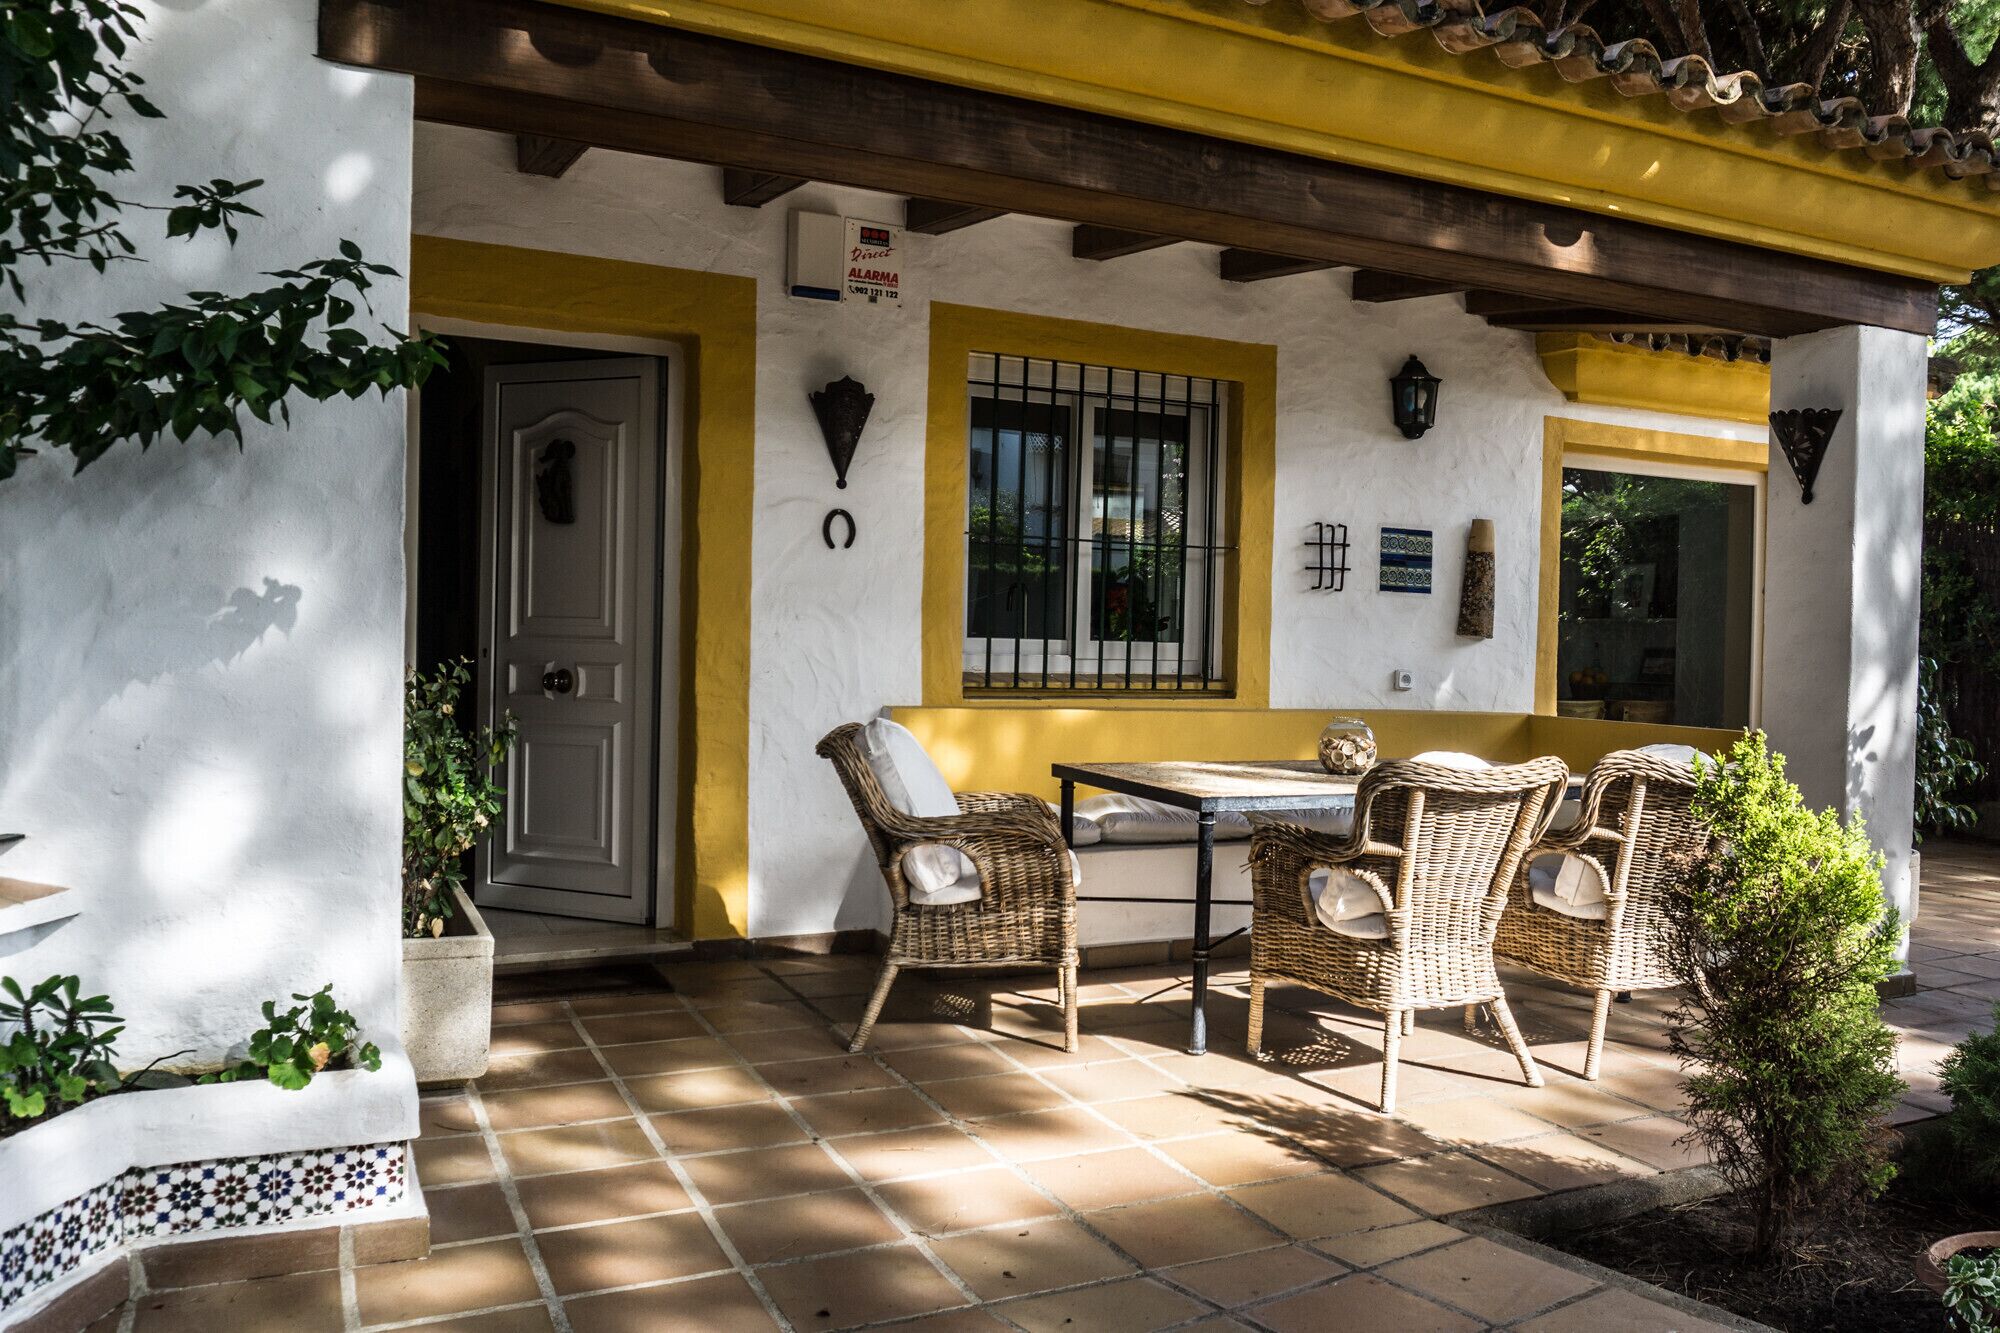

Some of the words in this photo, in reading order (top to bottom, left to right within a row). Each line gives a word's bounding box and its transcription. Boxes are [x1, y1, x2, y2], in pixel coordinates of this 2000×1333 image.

[851, 247, 896, 262] Direct
[848, 267, 898, 282] ALARMA
[854, 286, 868, 294] 902
[870, 288, 882, 296] 121
[885, 290, 898, 298] 122
